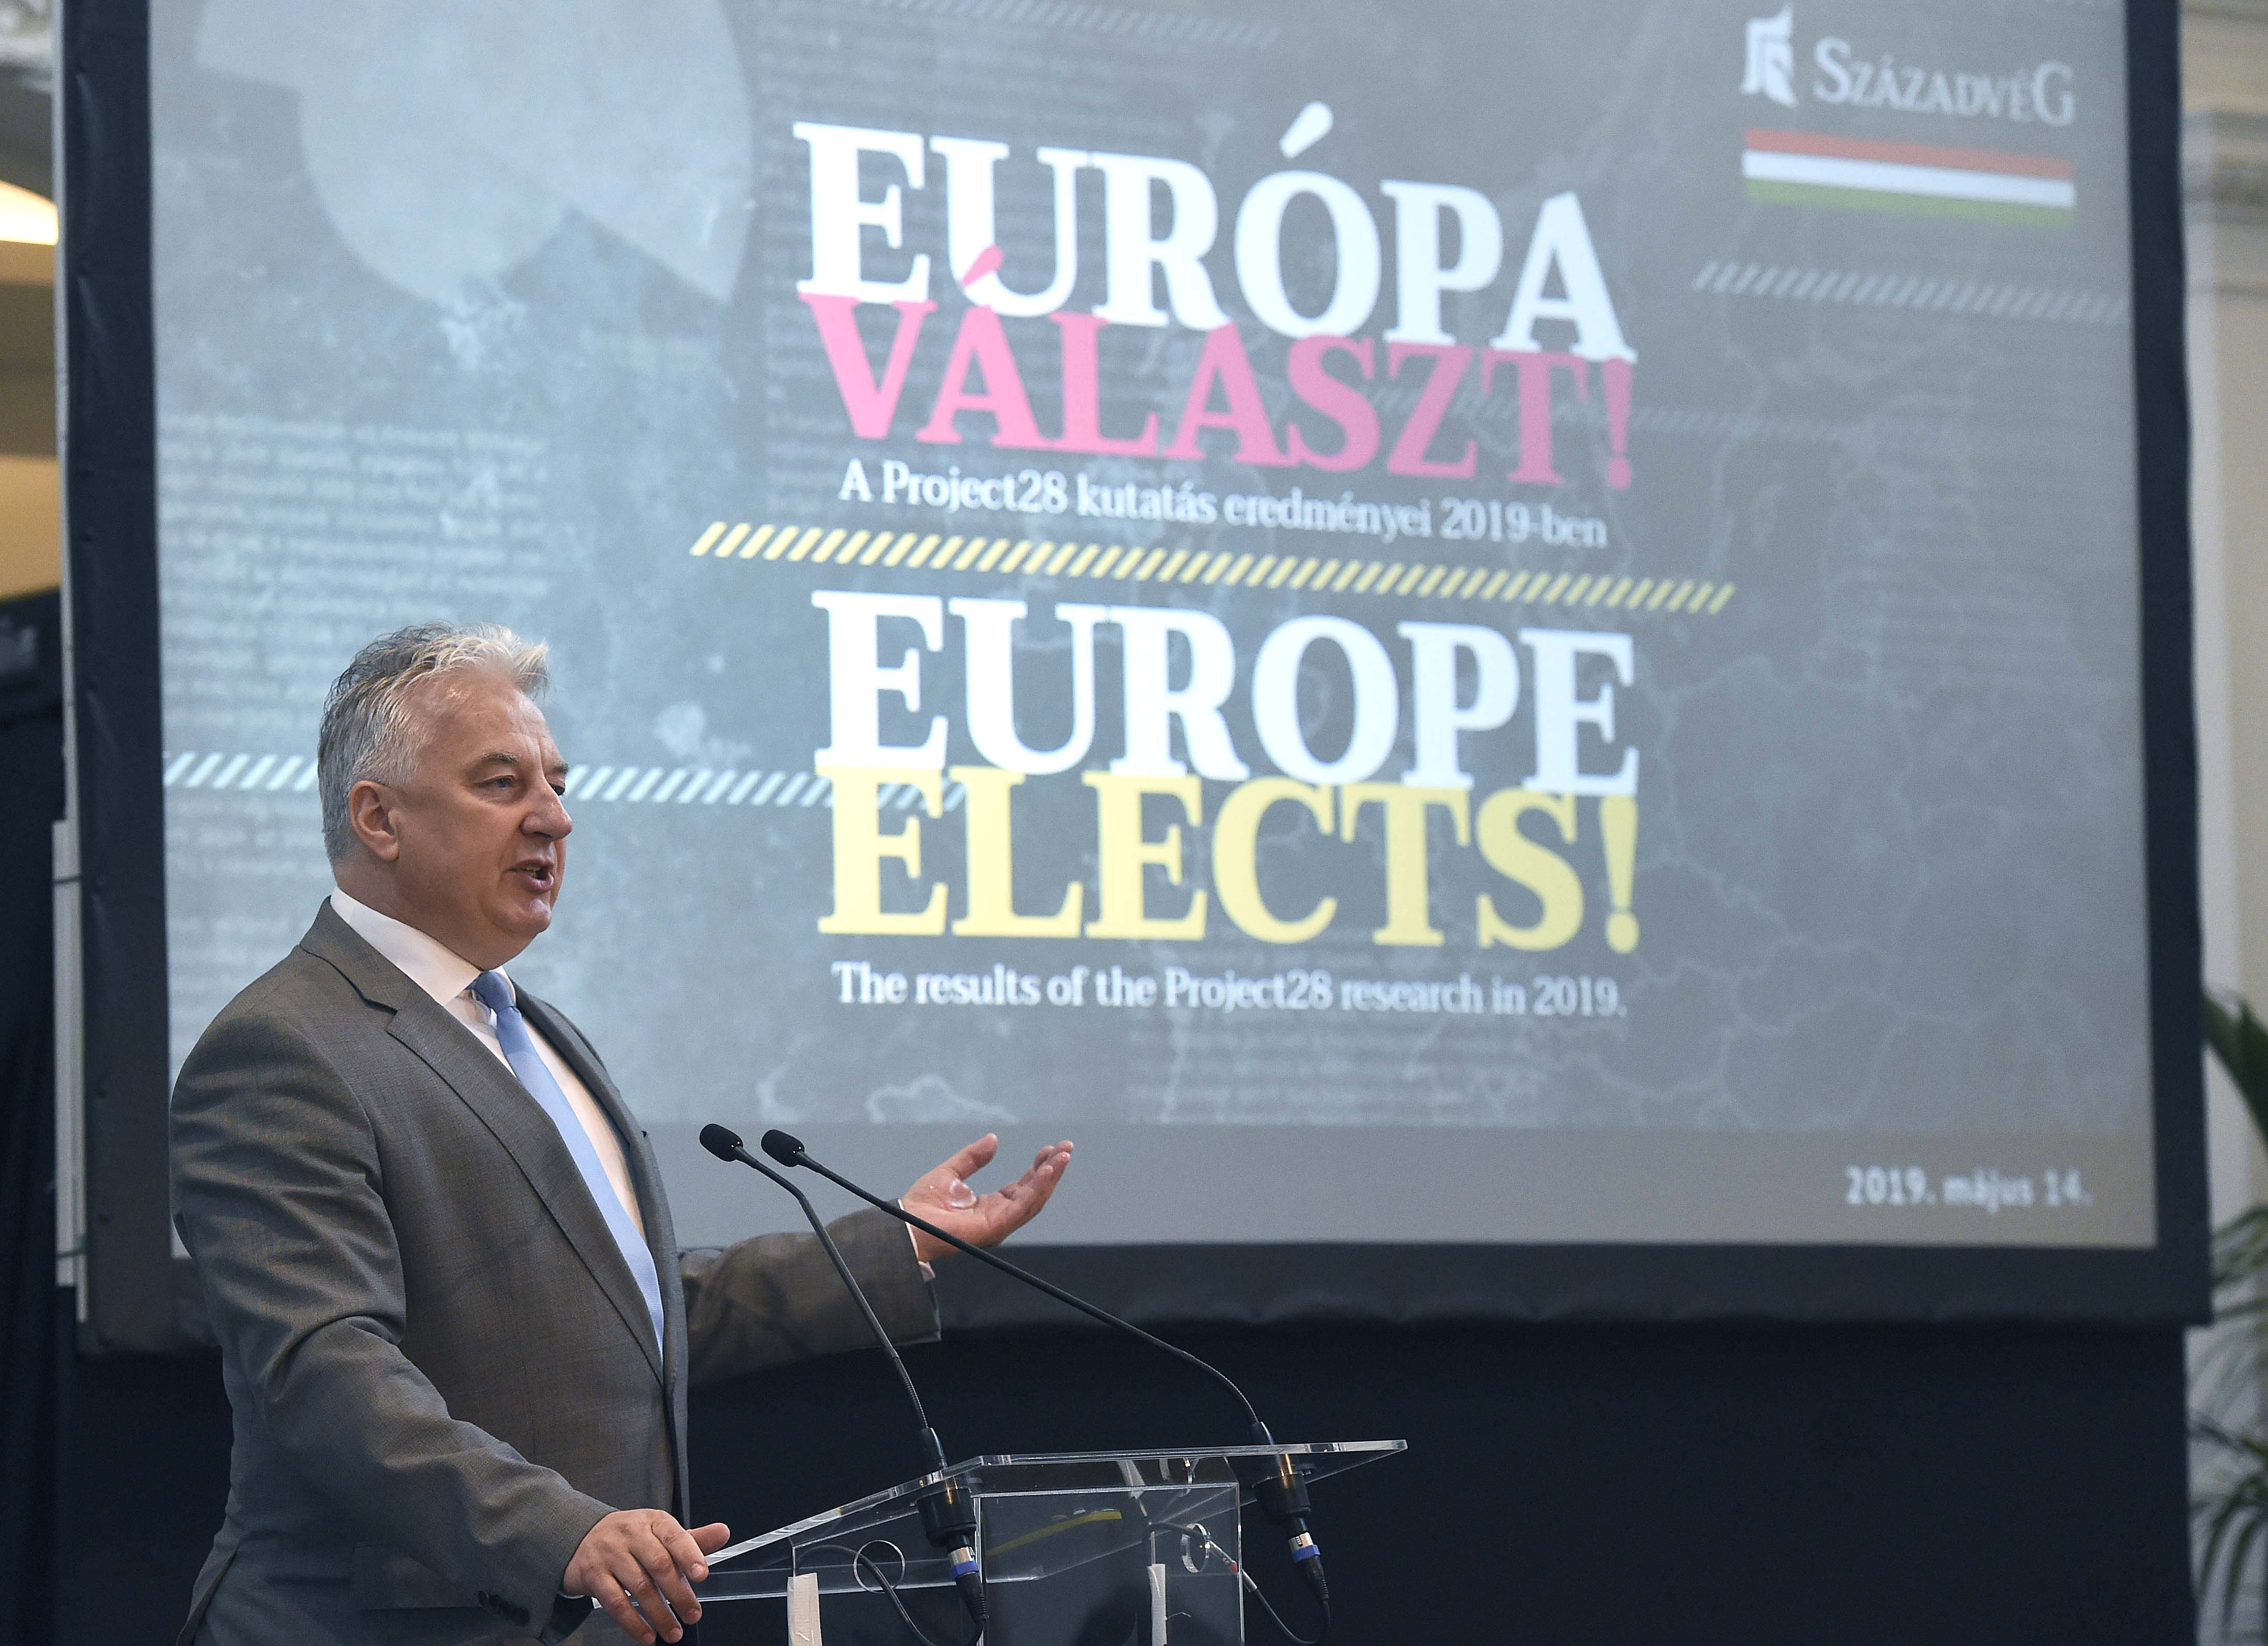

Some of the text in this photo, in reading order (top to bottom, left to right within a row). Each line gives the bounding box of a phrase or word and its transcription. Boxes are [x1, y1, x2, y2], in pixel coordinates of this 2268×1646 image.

[793, 101, 1637, 363] EURÓPA
[799, 243, 1633, 490] VÁLASZT!
[838, 458, 1607, 547] A Project28 kutatás eredményei 2019-ben
[811, 590, 1639, 796] EUROPE
[818, 765, 1641, 954] ELECTS!
[831, 961, 1627, 1017] The results of the Project28 research in 2019.
[1845, 1165, 2093, 1214] 2019. május 14.
